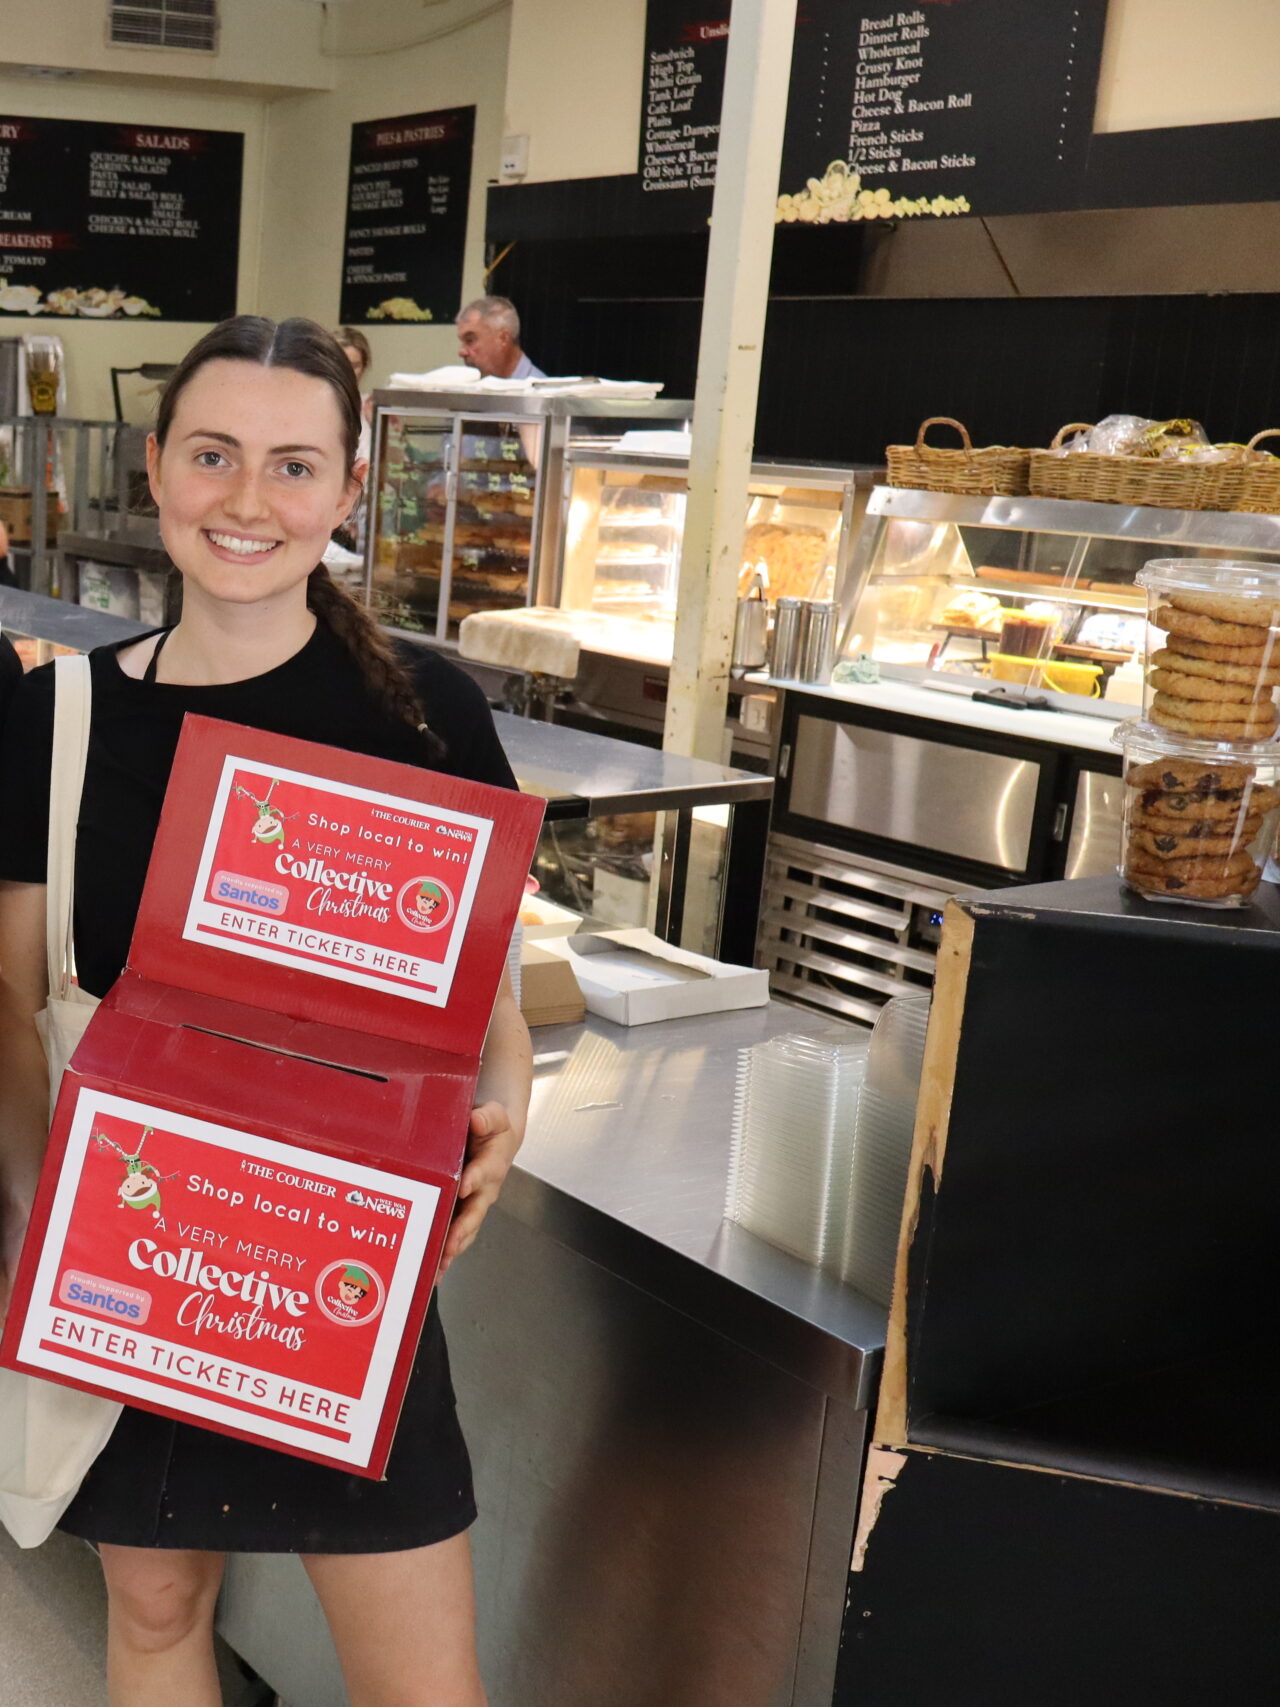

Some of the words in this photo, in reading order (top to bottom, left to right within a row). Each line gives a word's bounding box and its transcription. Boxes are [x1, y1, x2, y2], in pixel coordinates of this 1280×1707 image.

[861, 15, 894, 31] Bread
[897, 11, 925, 26] Rolls
[860, 32, 898, 47] Dinner
[901, 25, 930, 40] Rolls
[650, 46, 695, 63] Sandwich
[858, 41, 920, 60] Wholemeal
[856, 61, 893, 76] Crusty
[895, 57, 923, 71] Knot
[855, 72, 920, 90] Hamburger
[852, 104, 891, 119] Cheese
[894, 101, 904, 114] &
[908, 98, 944, 113] Bacon
[947, 93, 972, 108] Roll
[853, 90, 876, 104] Hot
[878, 88, 903, 104] Dog
[849, 132, 887, 147] French
[890, 128, 924, 143] Sticks
[851, 119, 880, 133] Pizza
[136, 133, 190, 150] SALADS
[848, 148, 866, 161] 1/2
[868, 146, 902, 159] Sticks
[848, 162, 885, 175] Cheese
[887, 160, 899, 173] &
[902, 158, 938, 172] Bacon
[940, 154, 976, 169] Sticks
[375, 810, 392, 820] THE
[393, 815, 430, 831] COURIER
[307, 813, 350, 836] Shop
[358, 825, 401, 847] local
[408, 838, 424, 853] to
[432, 848, 468, 865] win!
[292, 839, 300, 849] A
[307, 842, 340, 859] VERY
[345, 851, 392, 871] MERRY
[274, 853, 393, 901] Collective
[218, 882, 279, 910] Santos
[306, 886, 391, 923] Christmas
[220, 912, 279, 939] ENTER
[287, 930, 365, 962] TICKETS
[372, 952, 420, 977] HERE
[247, 1162, 275, 1180] THE
[276, 1171, 337, 1198] COURIER
[186, 1175, 244, 1207] Shop
[253, 1193, 311, 1225] local
[318, 1212, 339, 1233] to
[350, 1225, 398, 1250] win!
[364, 1196, 406, 1219] News
[154, 1217, 167, 1232] A
[178, 1222, 229, 1249] VERY
[236, 1240, 308, 1273] MERRY
[128, 1238, 310, 1317] Collective
[67, 1283, 140, 1318] Santos
[176, 1291, 306, 1351] Christmas
[51, 1317, 138, 1359] ENTER
[151, 1345, 267, 1398] TICKETS
[279, 1389, 351, 1424] HERE
